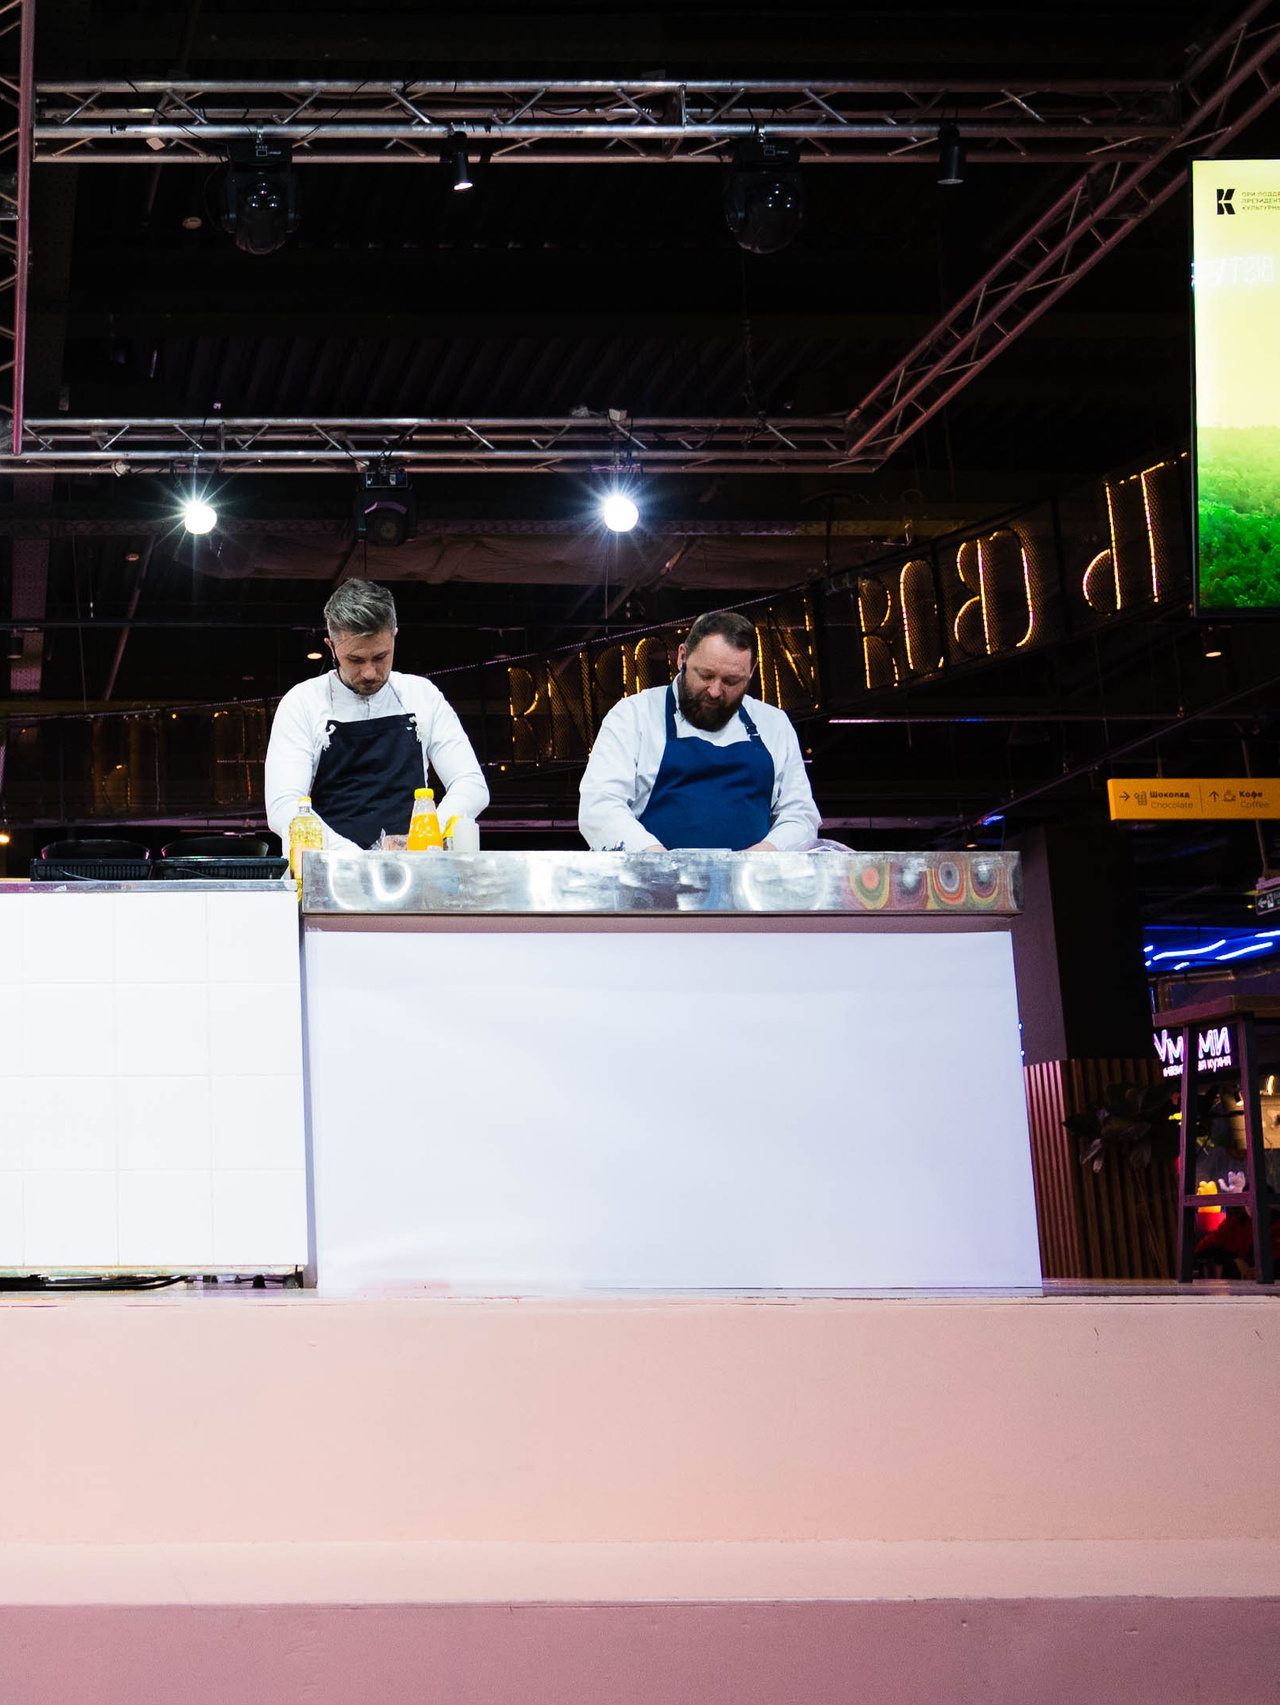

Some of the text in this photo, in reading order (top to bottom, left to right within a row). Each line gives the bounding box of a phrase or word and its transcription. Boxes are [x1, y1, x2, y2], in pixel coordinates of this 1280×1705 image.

[1149, 790, 1190, 799] Шоколад
[1238, 790, 1263, 799] Кофе
[1150, 801, 1194, 809] Chocolate
[1240, 801, 1270, 809] Coffee
[1153, 1026, 1231, 1065] УММИ
